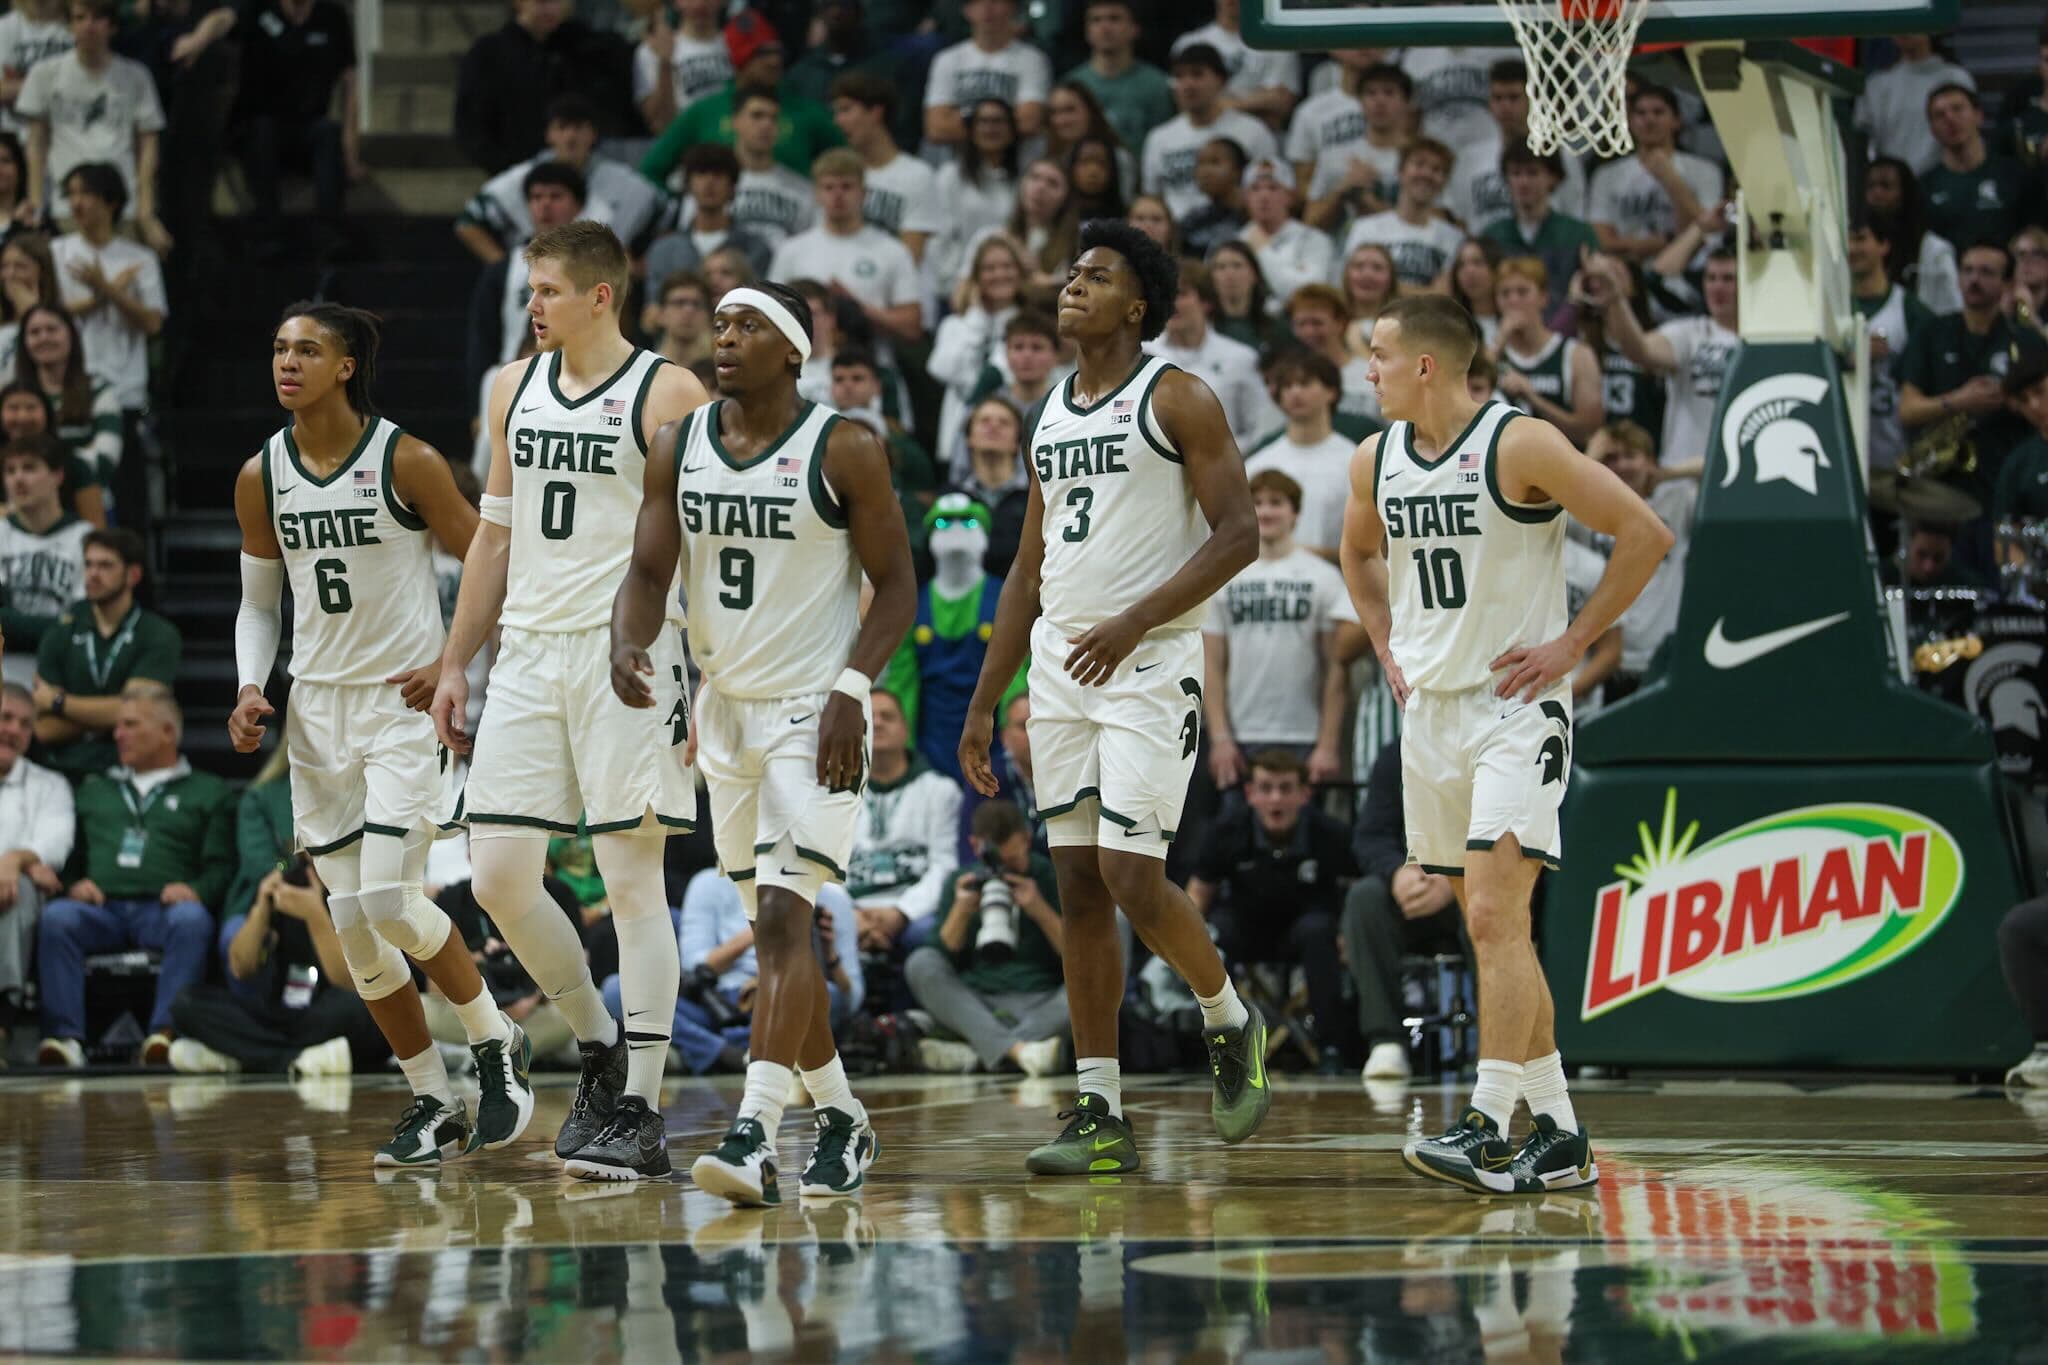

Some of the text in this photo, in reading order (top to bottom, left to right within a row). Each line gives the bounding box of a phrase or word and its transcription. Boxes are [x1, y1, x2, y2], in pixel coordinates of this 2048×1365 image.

[514, 432, 620, 475] STATE
[1036, 433, 1129, 482] STATE
[279, 507, 381, 549] STATE
[541, 480, 577, 540] 0
[682, 490, 797, 540] STATE
[1062, 486, 1094, 542] 3
[1384, 493, 1482, 538] STATE
[314, 558, 353, 615] 6
[718, 546, 755, 611] 9
[1412, 547, 1467, 609] 10
[1228, 597, 1312, 624] SHIELD
[1586, 834, 1929, 1012] LIBMAN
